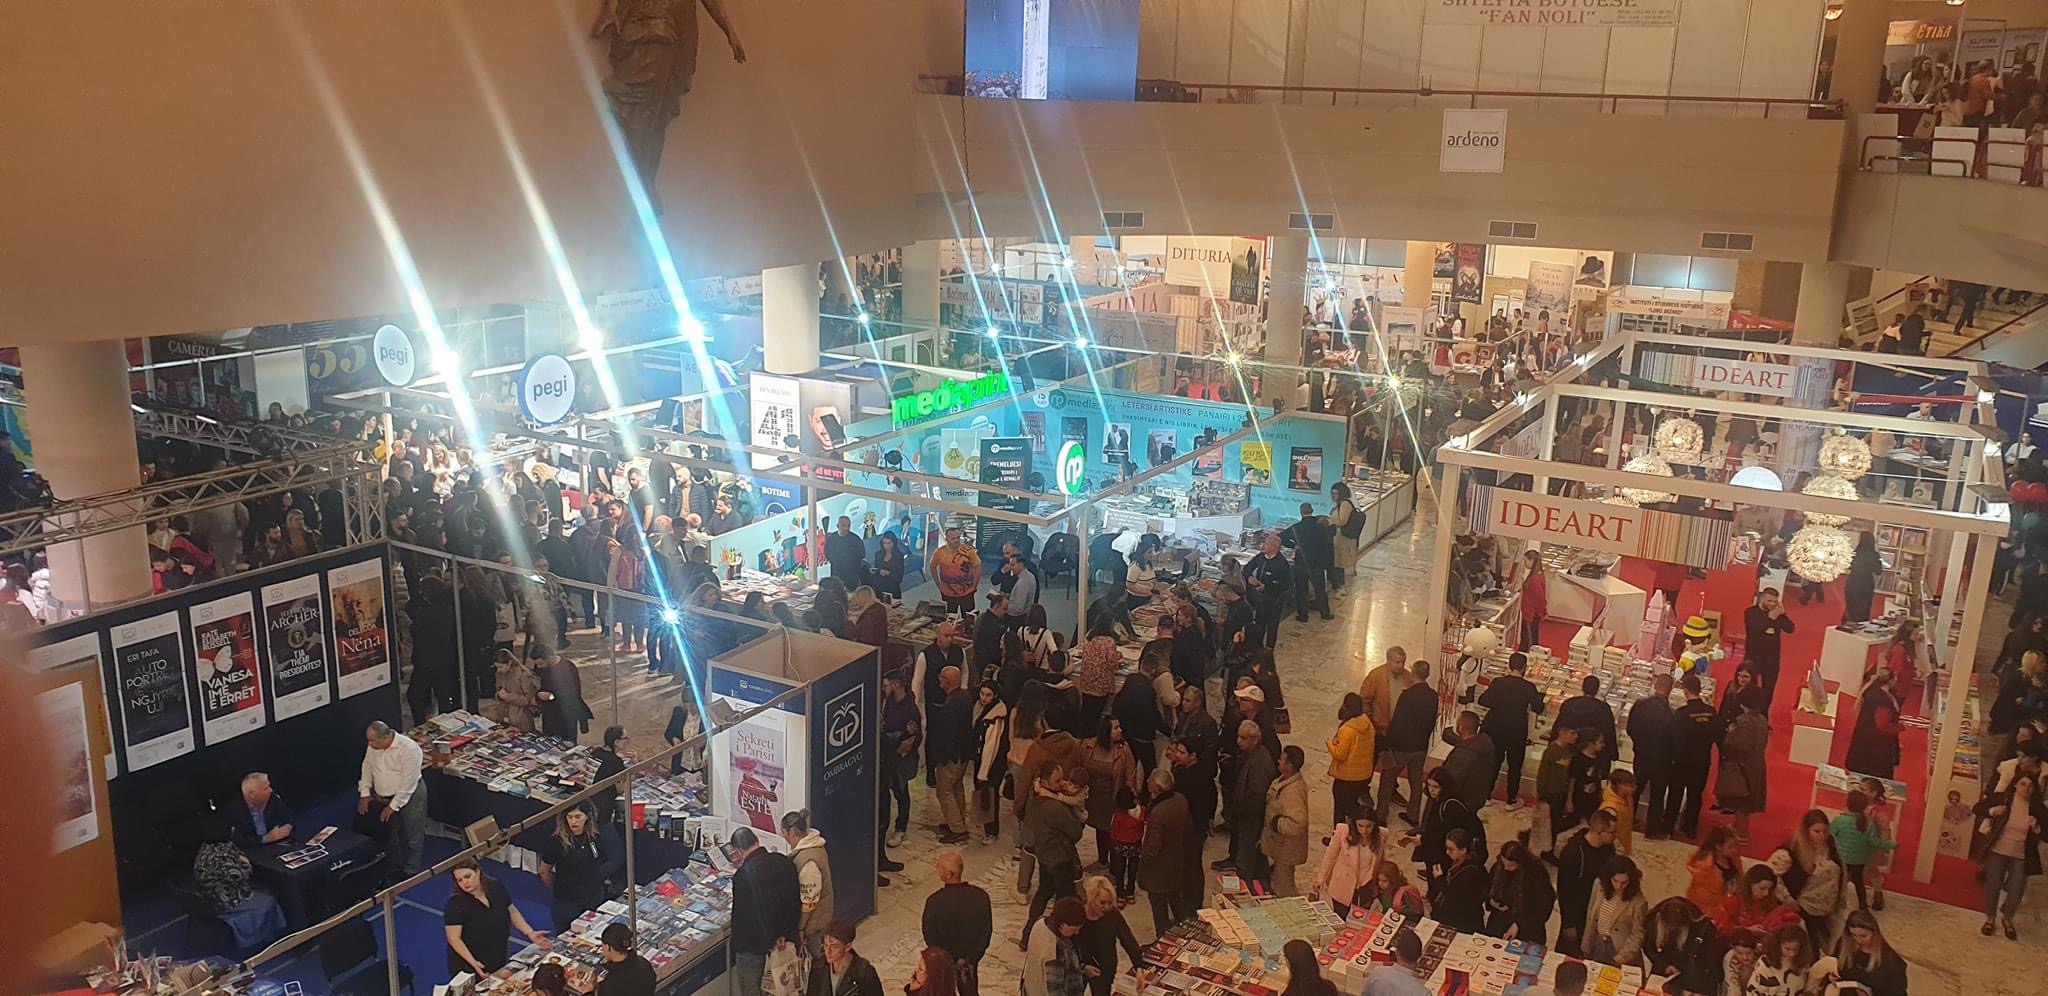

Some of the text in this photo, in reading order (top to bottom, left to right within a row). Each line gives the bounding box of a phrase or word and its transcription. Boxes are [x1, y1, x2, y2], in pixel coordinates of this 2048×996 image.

[1447, 130, 1499, 147] ardeno
[1172, 247, 1232, 264] DITURIA
[379, 346, 408, 364] pegi
[1701, 364, 1789, 389] IDEART
[533, 374, 568, 401] pegi
[1198, 409, 1231, 421] PANAIRI
[762, 486, 791, 498] BOTIME
[1500, 499, 1633, 543] IDEART
[271, 607, 319, 630] ARCHER
[341, 633, 381, 657] Nëna
[127, 648, 160, 663] ERI TAFA
[135, 659, 168, 676] AUTO
[207, 668, 254, 689] VANESA
[208, 685, 230, 700] IME
[209, 685, 256, 710] E ERRËT
[737, 729, 774, 750] Sekreti
[743, 742, 775, 762] Parisit
